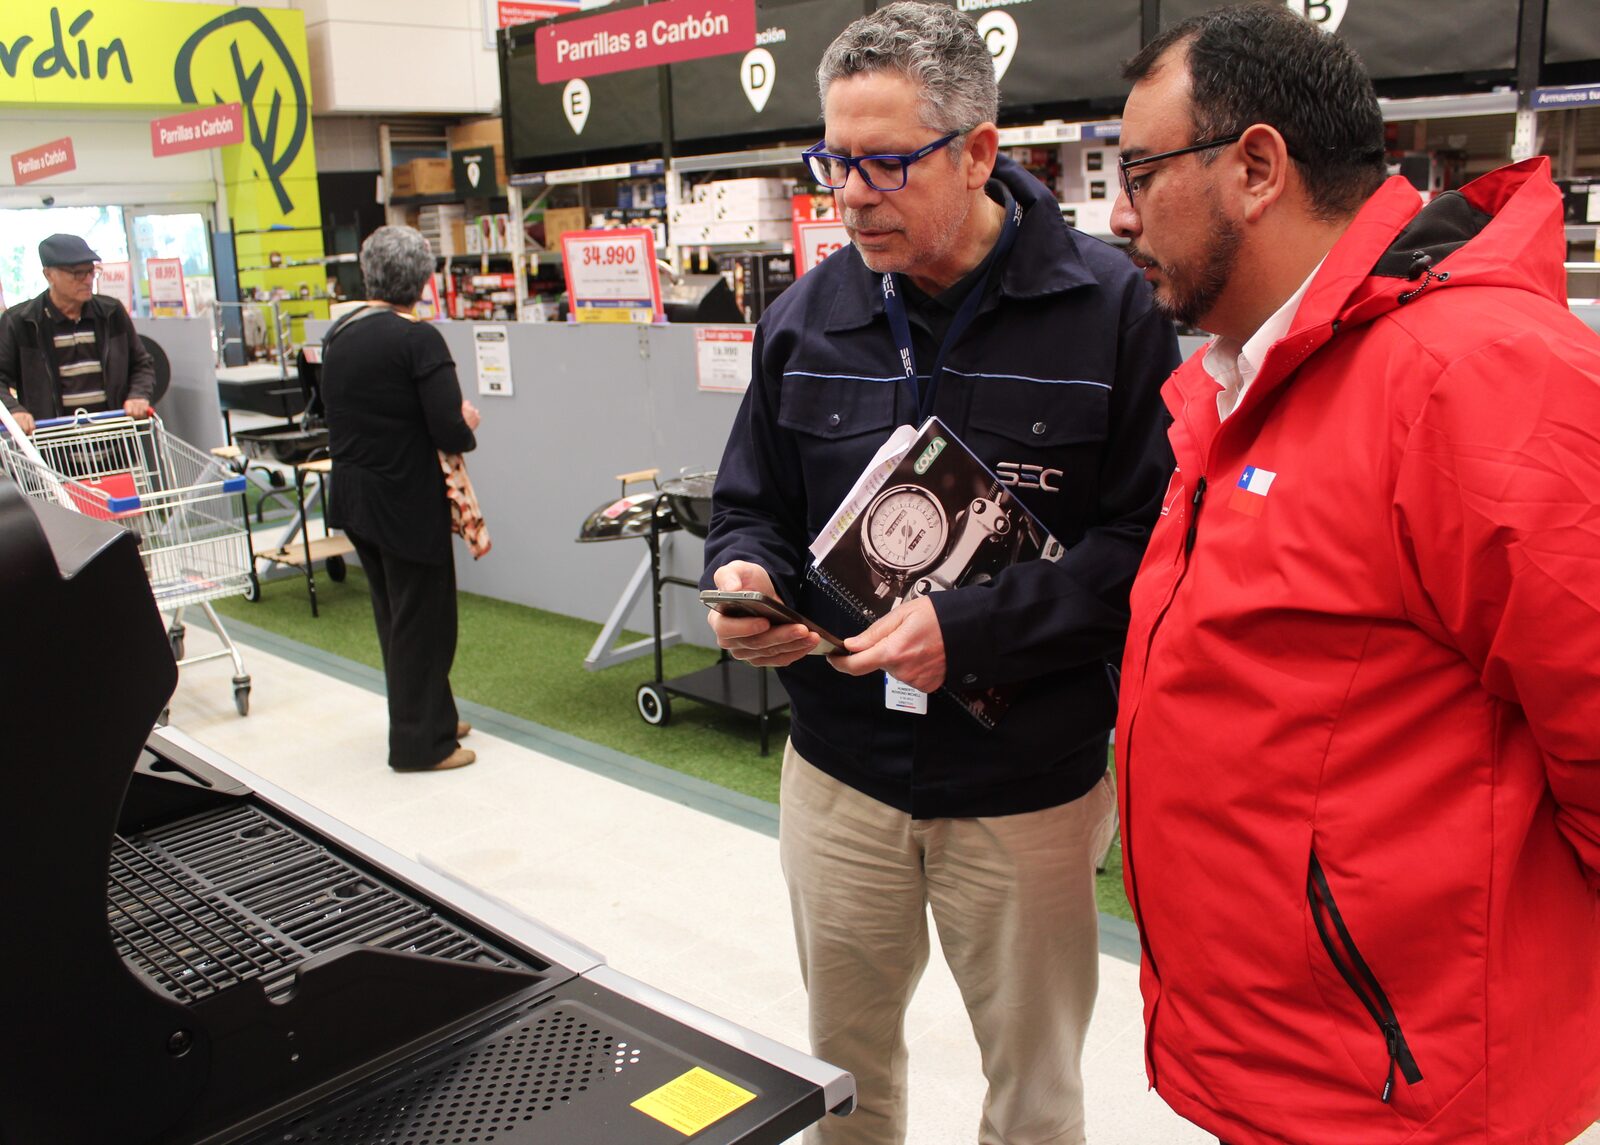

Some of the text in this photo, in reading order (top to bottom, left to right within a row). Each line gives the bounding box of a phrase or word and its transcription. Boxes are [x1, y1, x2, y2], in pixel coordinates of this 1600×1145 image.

[1304, 0, 1331, 23] B
[556, 11, 730, 64] Parrillas a Carbón
[983, 26, 1005, 58] C
[750, 62, 767, 90] D
[571, 91, 583, 116] E
[1538, 92, 1587, 104] Armamos
[160, 115, 233, 145] Parrillas a Carbón
[18, 156, 41, 175] Parrillas
[44, 148, 67, 167] Carbón
[1013, 201, 1024, 227] SEC
[583, 245, 636, 266] 34.990
[882, 272, 896, 300] SEC
[900, 347, 914, 378] SEC
[996, 462, 1064, 492] SEC
